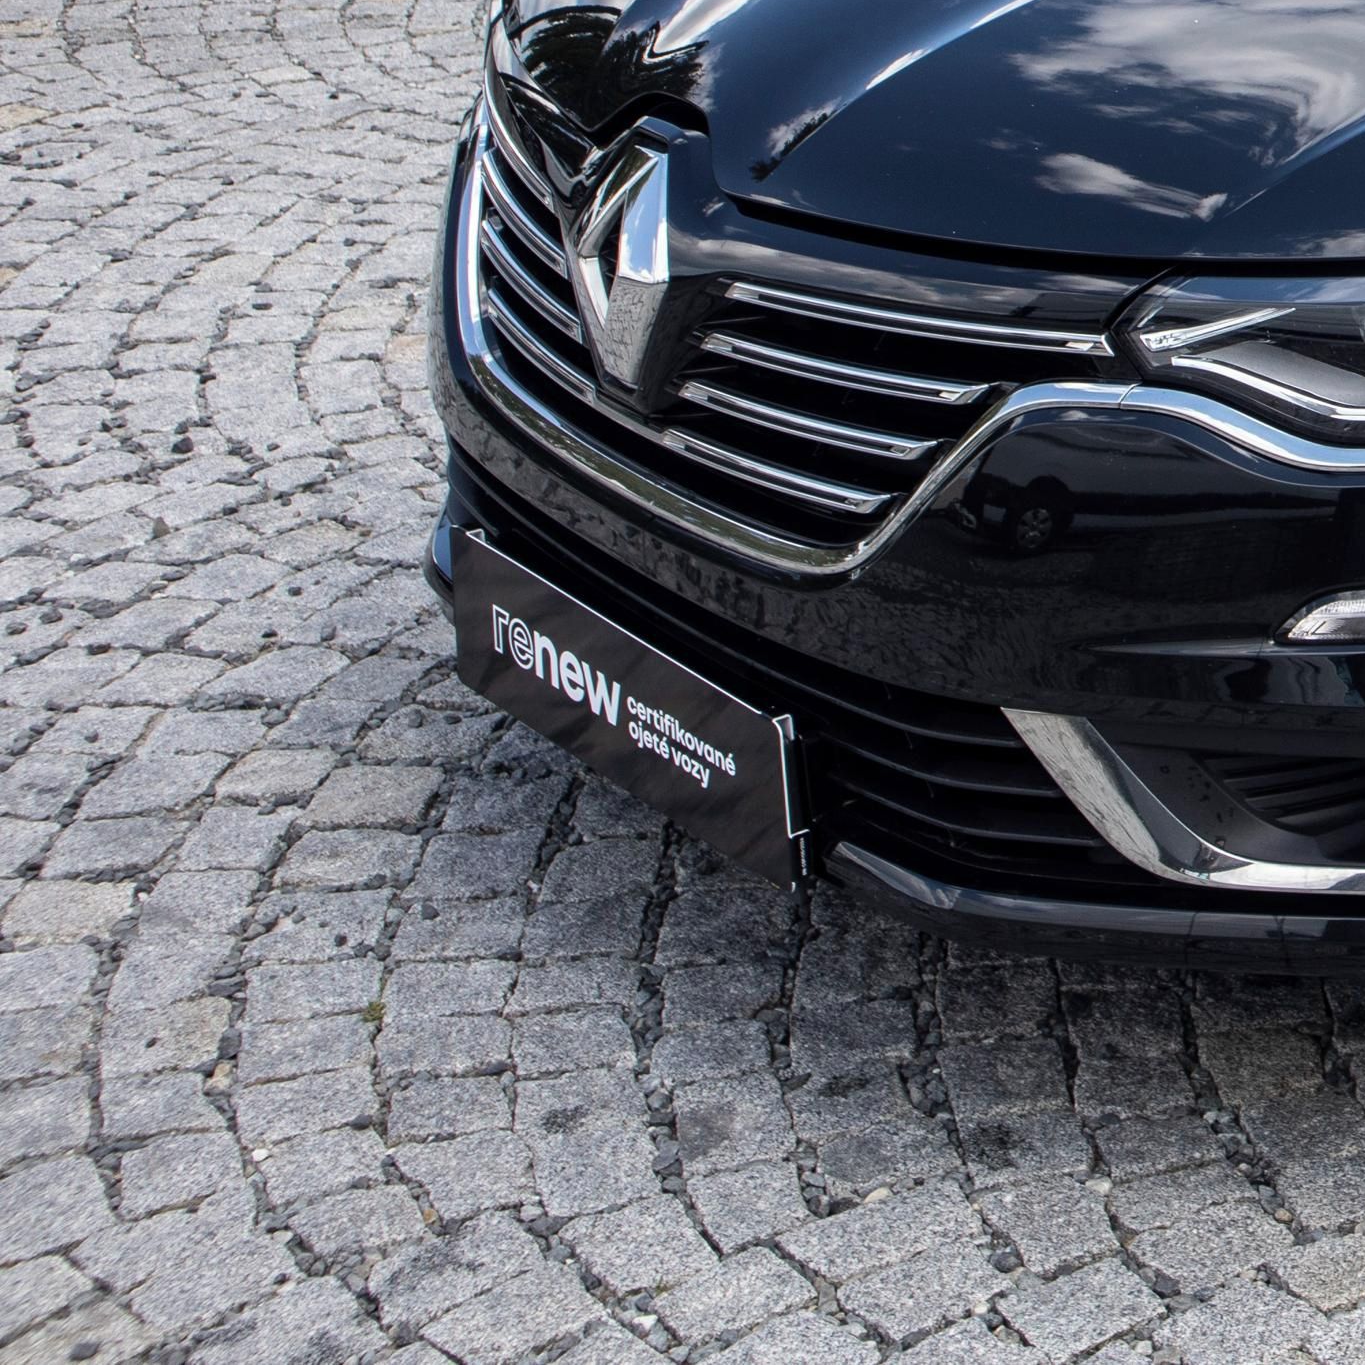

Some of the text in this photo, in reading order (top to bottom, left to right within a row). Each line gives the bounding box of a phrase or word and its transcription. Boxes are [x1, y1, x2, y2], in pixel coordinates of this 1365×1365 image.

[492, 604, 621, 726] renew
[626, 695, 737, 776] certifikované
[628, 720, 711, 788] ojeté vozy
